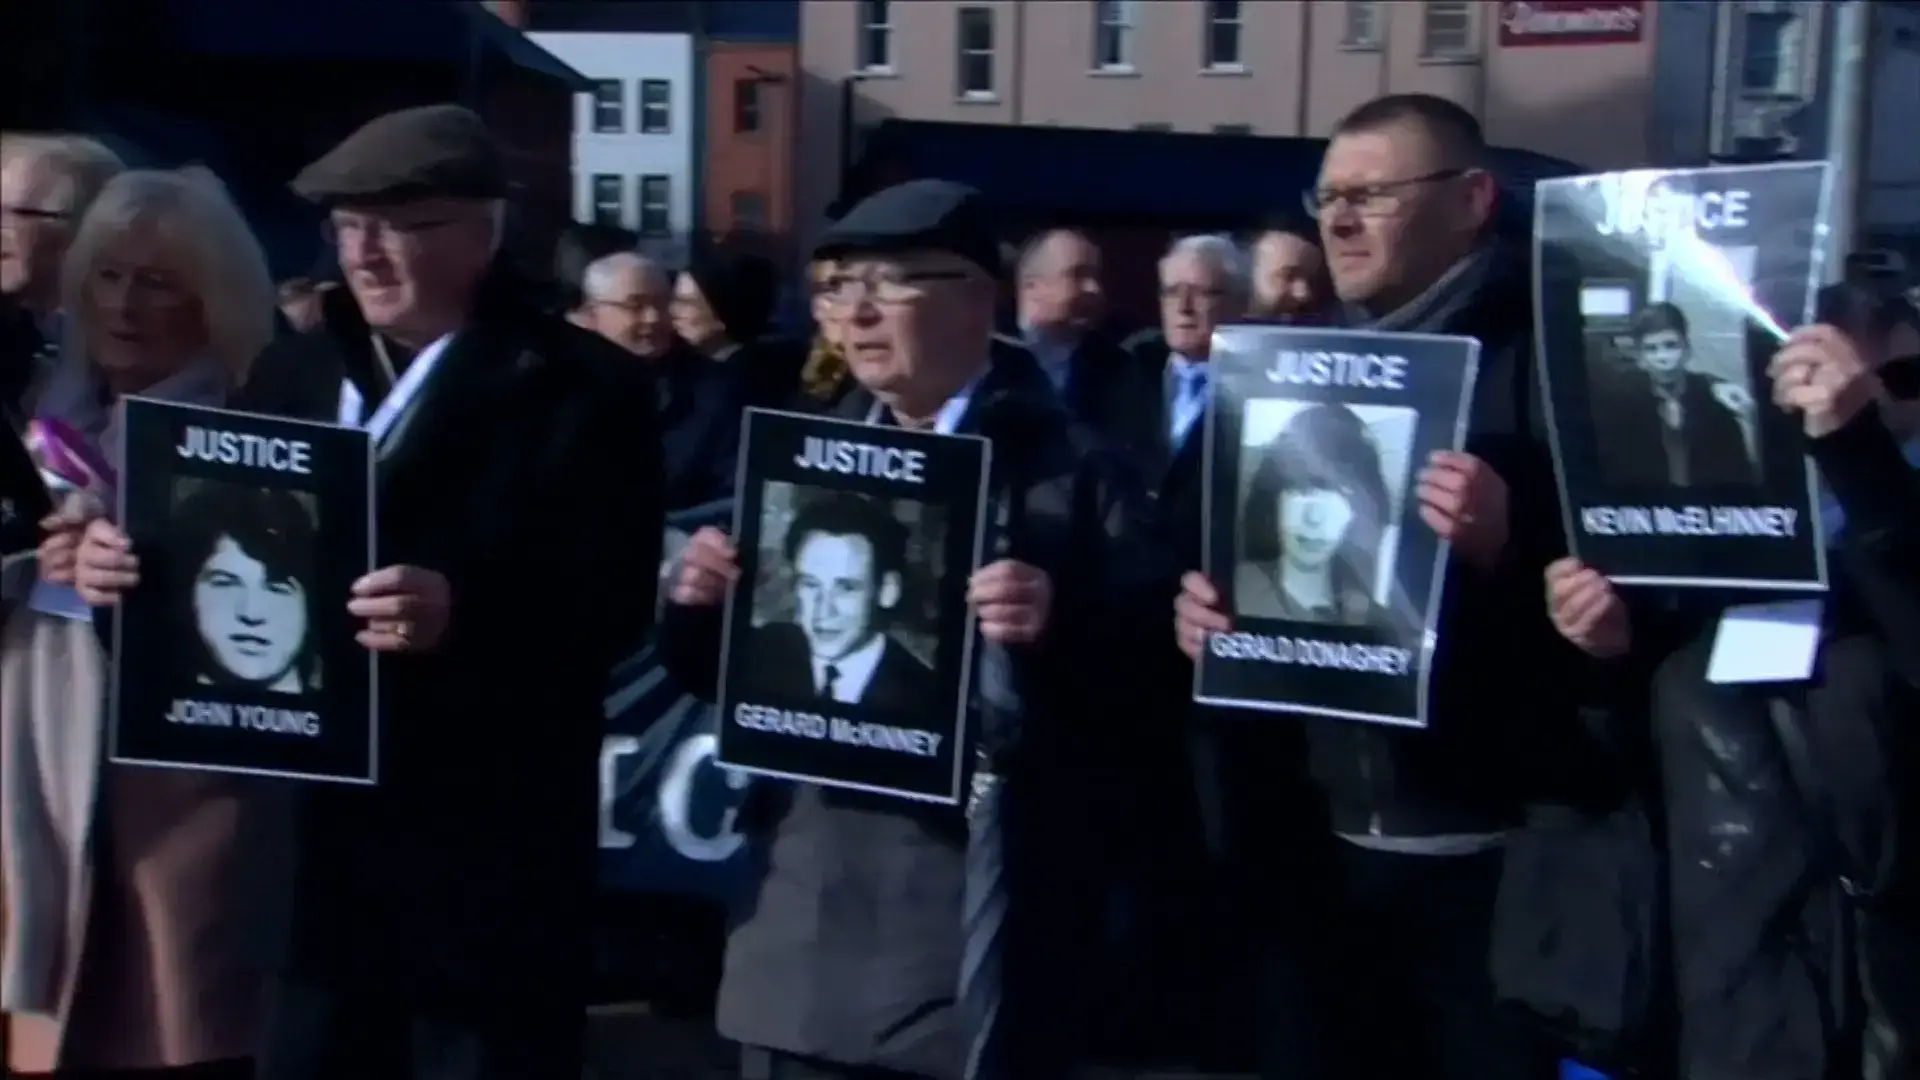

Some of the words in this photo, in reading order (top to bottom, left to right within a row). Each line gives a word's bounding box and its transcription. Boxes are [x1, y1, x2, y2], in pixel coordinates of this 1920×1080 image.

[1596, 187, 1751, 235] JUCE
[1266, 351, 1408, 390] JUSTICE
[176, 426, 311, 474] JUSTICE
[794, 436, 927, 483] JUSTICE
[1580, 505, 1653, 536] KEVIN
[1209, 631, 1294, 664] GERALD
[165, 699, 236, 728] JOHN
[238, 704, 320, 736] YOUNG
[734, 702, 828, 741] GERARD
